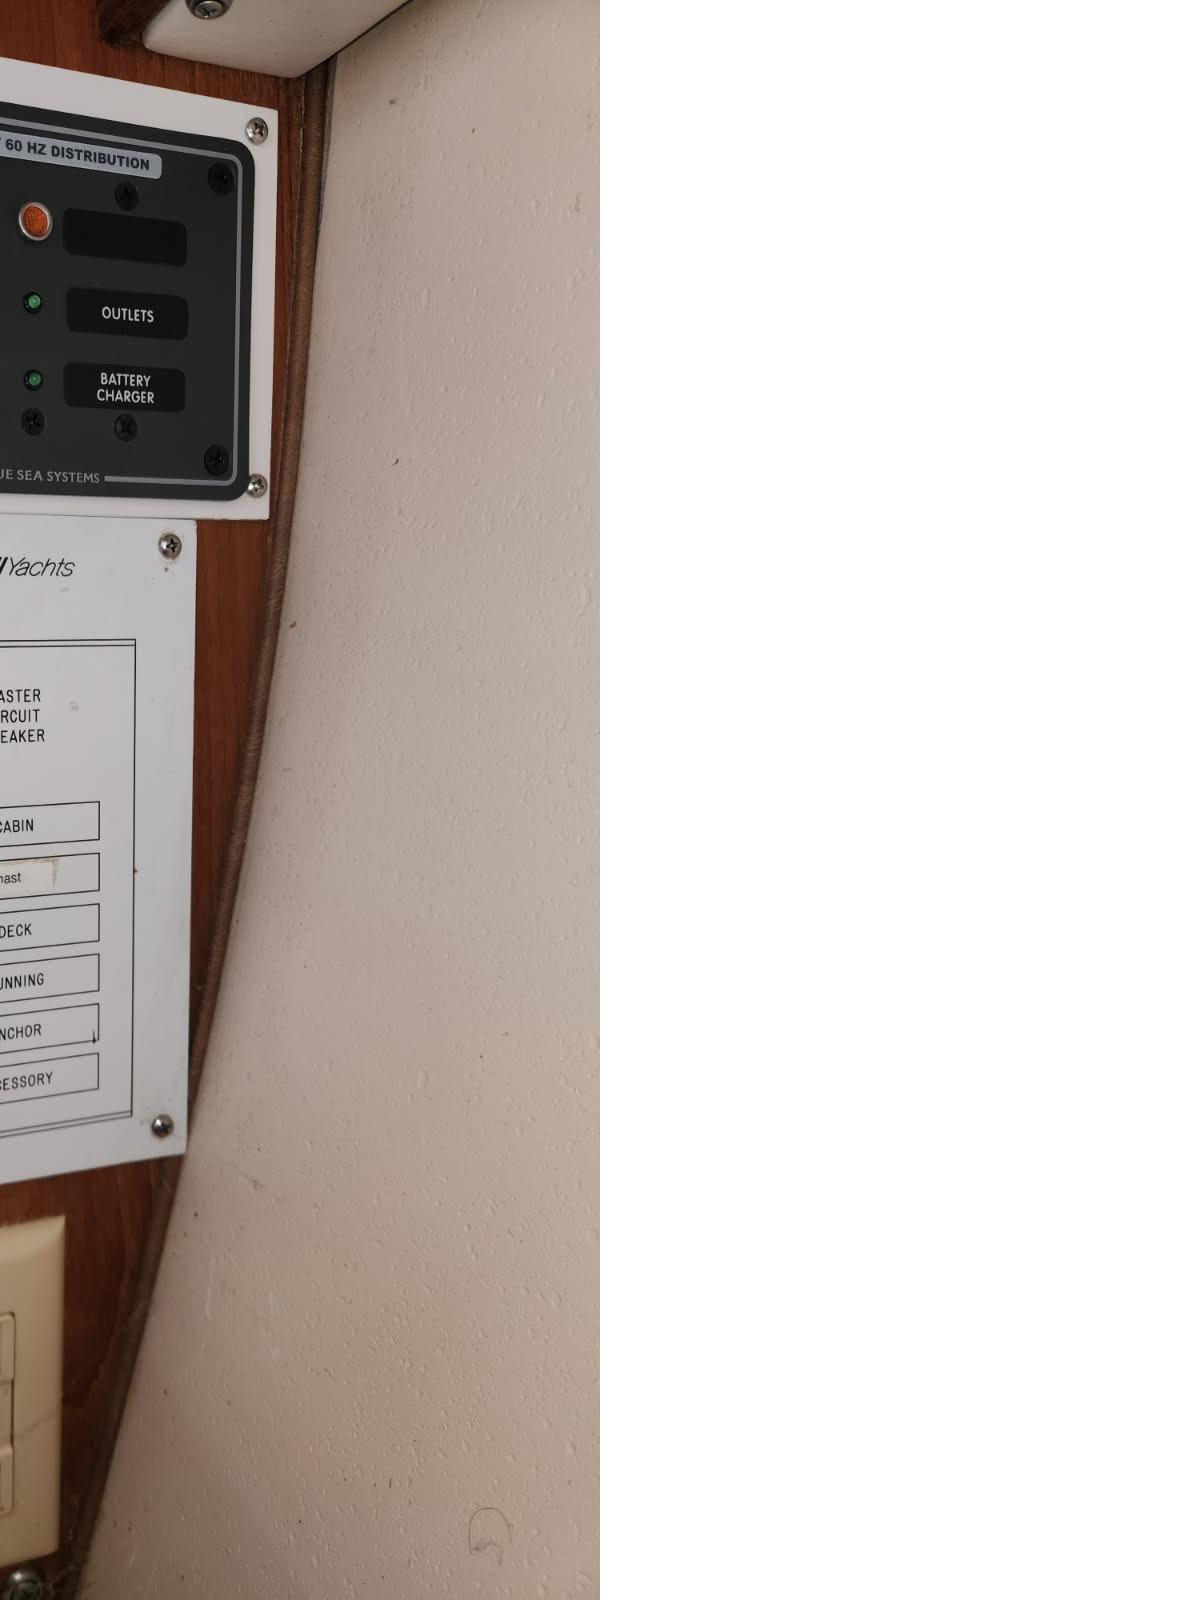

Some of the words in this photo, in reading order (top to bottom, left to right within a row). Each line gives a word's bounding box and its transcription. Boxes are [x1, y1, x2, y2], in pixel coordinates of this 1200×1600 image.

[5, 138, 23, 152] 60
[27, 141, 47, 156] HZ
[50, 145, 150, 172] DISTRIBUTION
[101, 306, 155, 323] OUTLETS
[100, 372, 151, 388] BATTERY
[96, 388, 155, 404] CHARGER
[16, 469, 44, 482] SEA
[46, 470, 100, 484] SYSTEMS
[8, 556, 76, 577] Yachts
